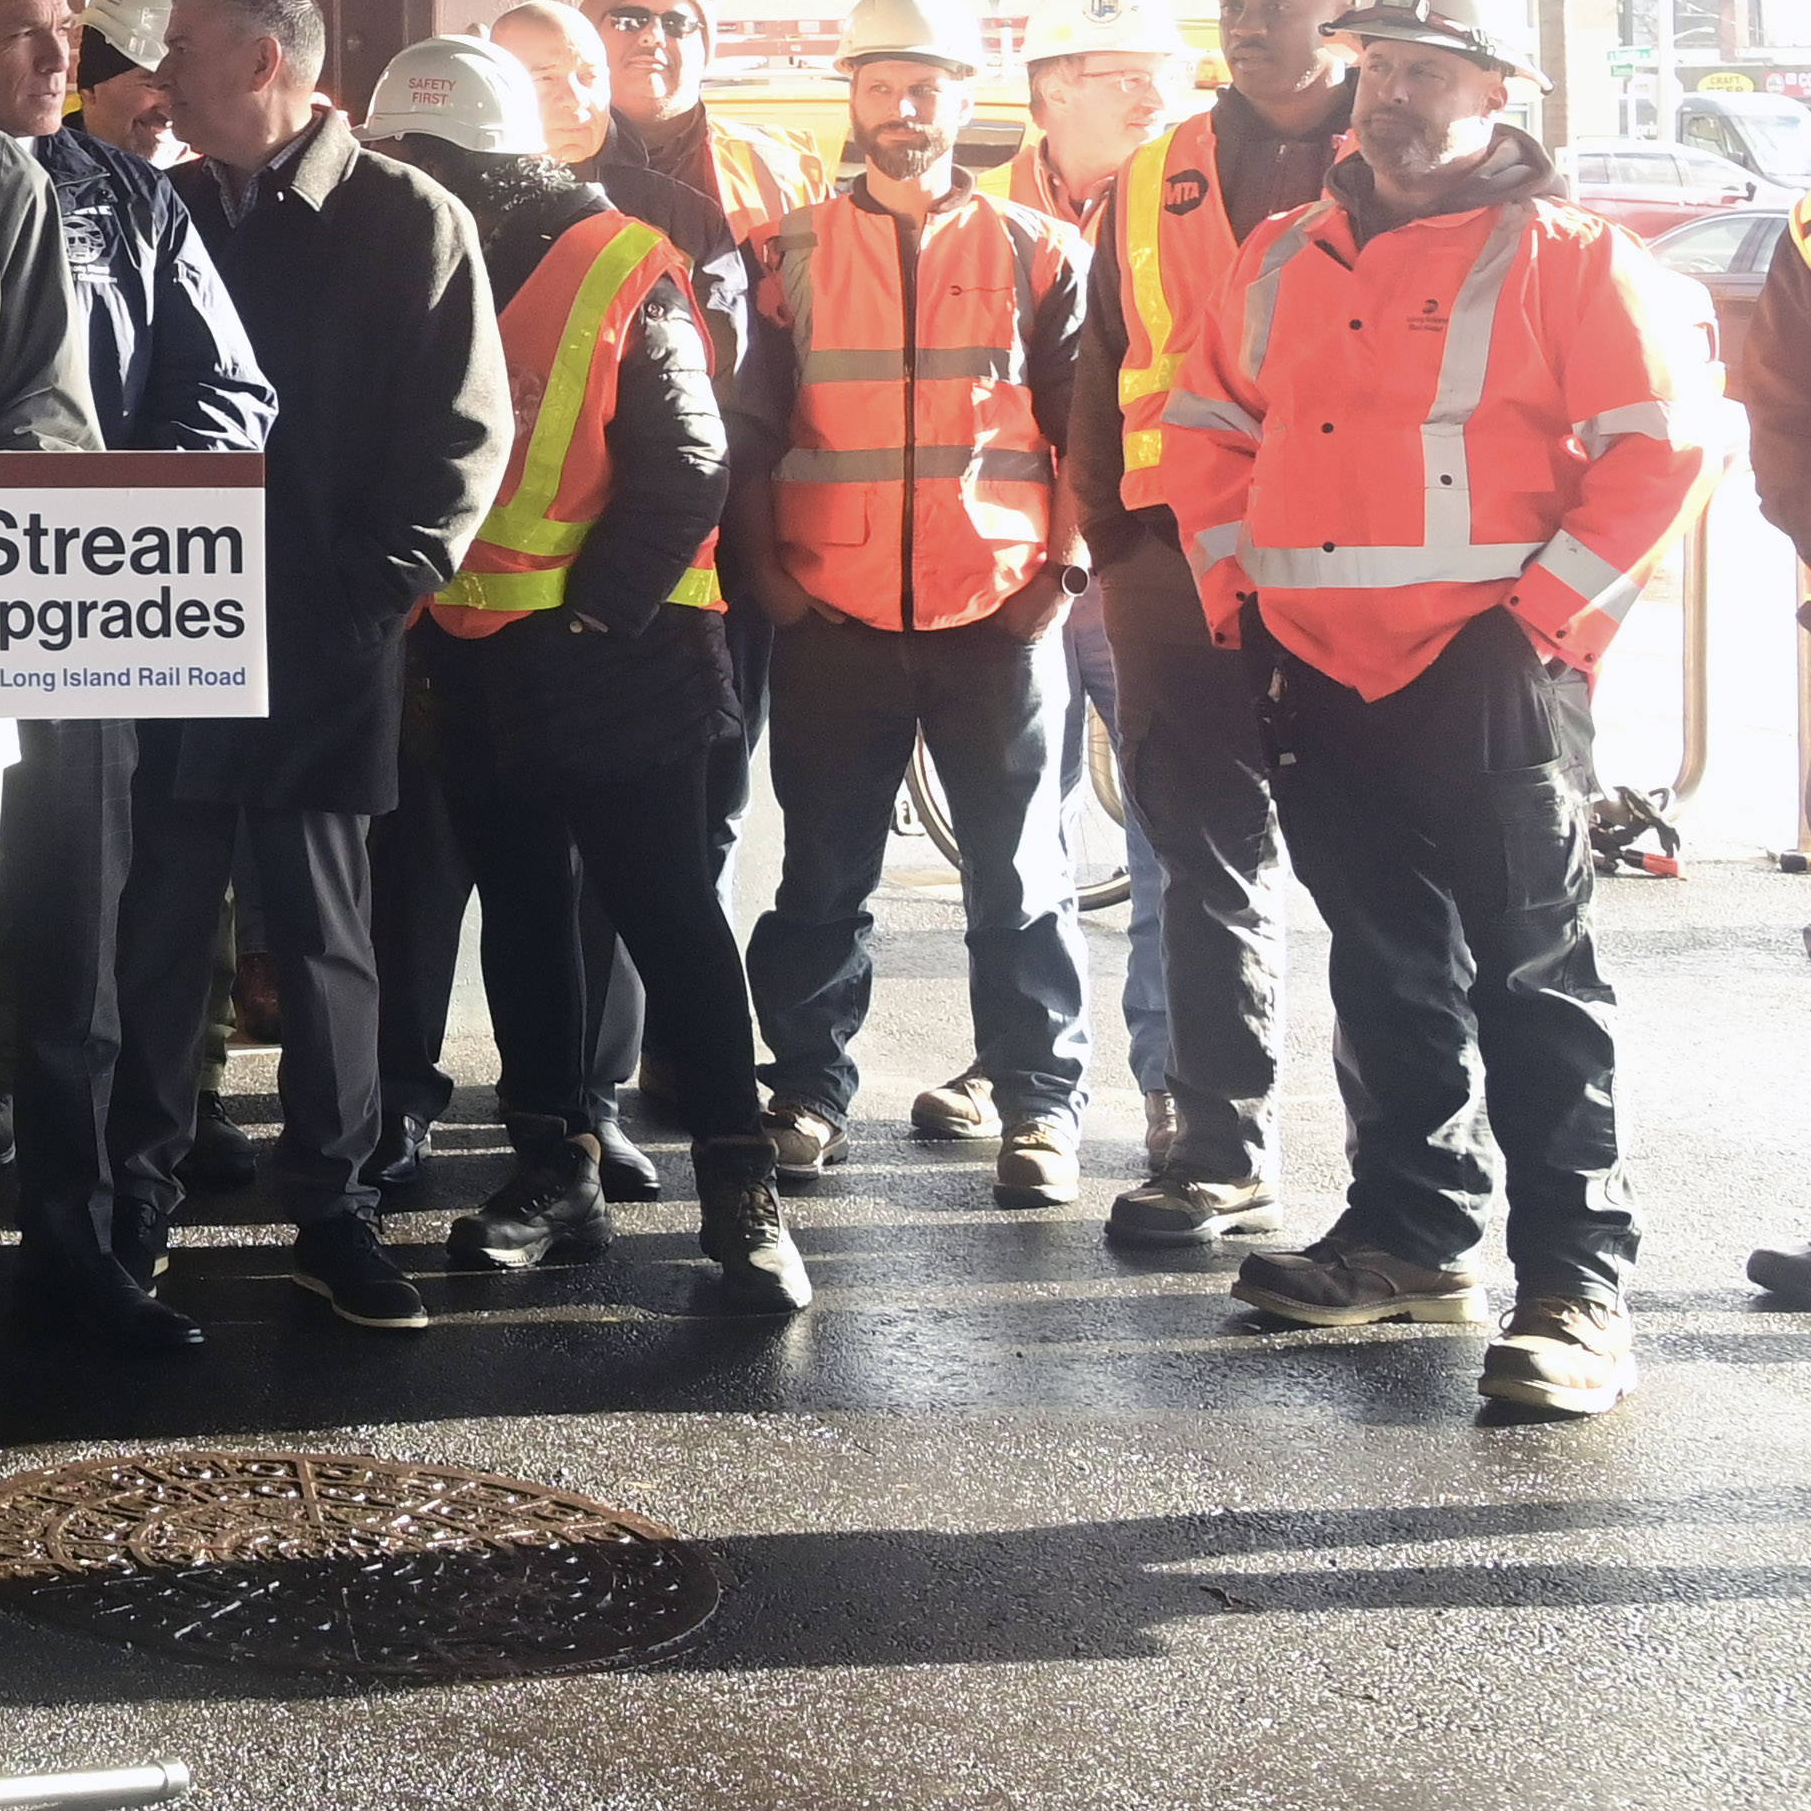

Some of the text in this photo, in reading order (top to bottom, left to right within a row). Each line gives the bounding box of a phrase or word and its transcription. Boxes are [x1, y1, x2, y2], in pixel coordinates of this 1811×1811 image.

[408, 77, 458, 92] SAFETY
[1709, 76, 1741, 86] CRAFT
[411, 91, 449, 106] FIRST
[1164, 181, 1201, 206] MTA
[0, 666, 247, 693] Long Island Rail Road
